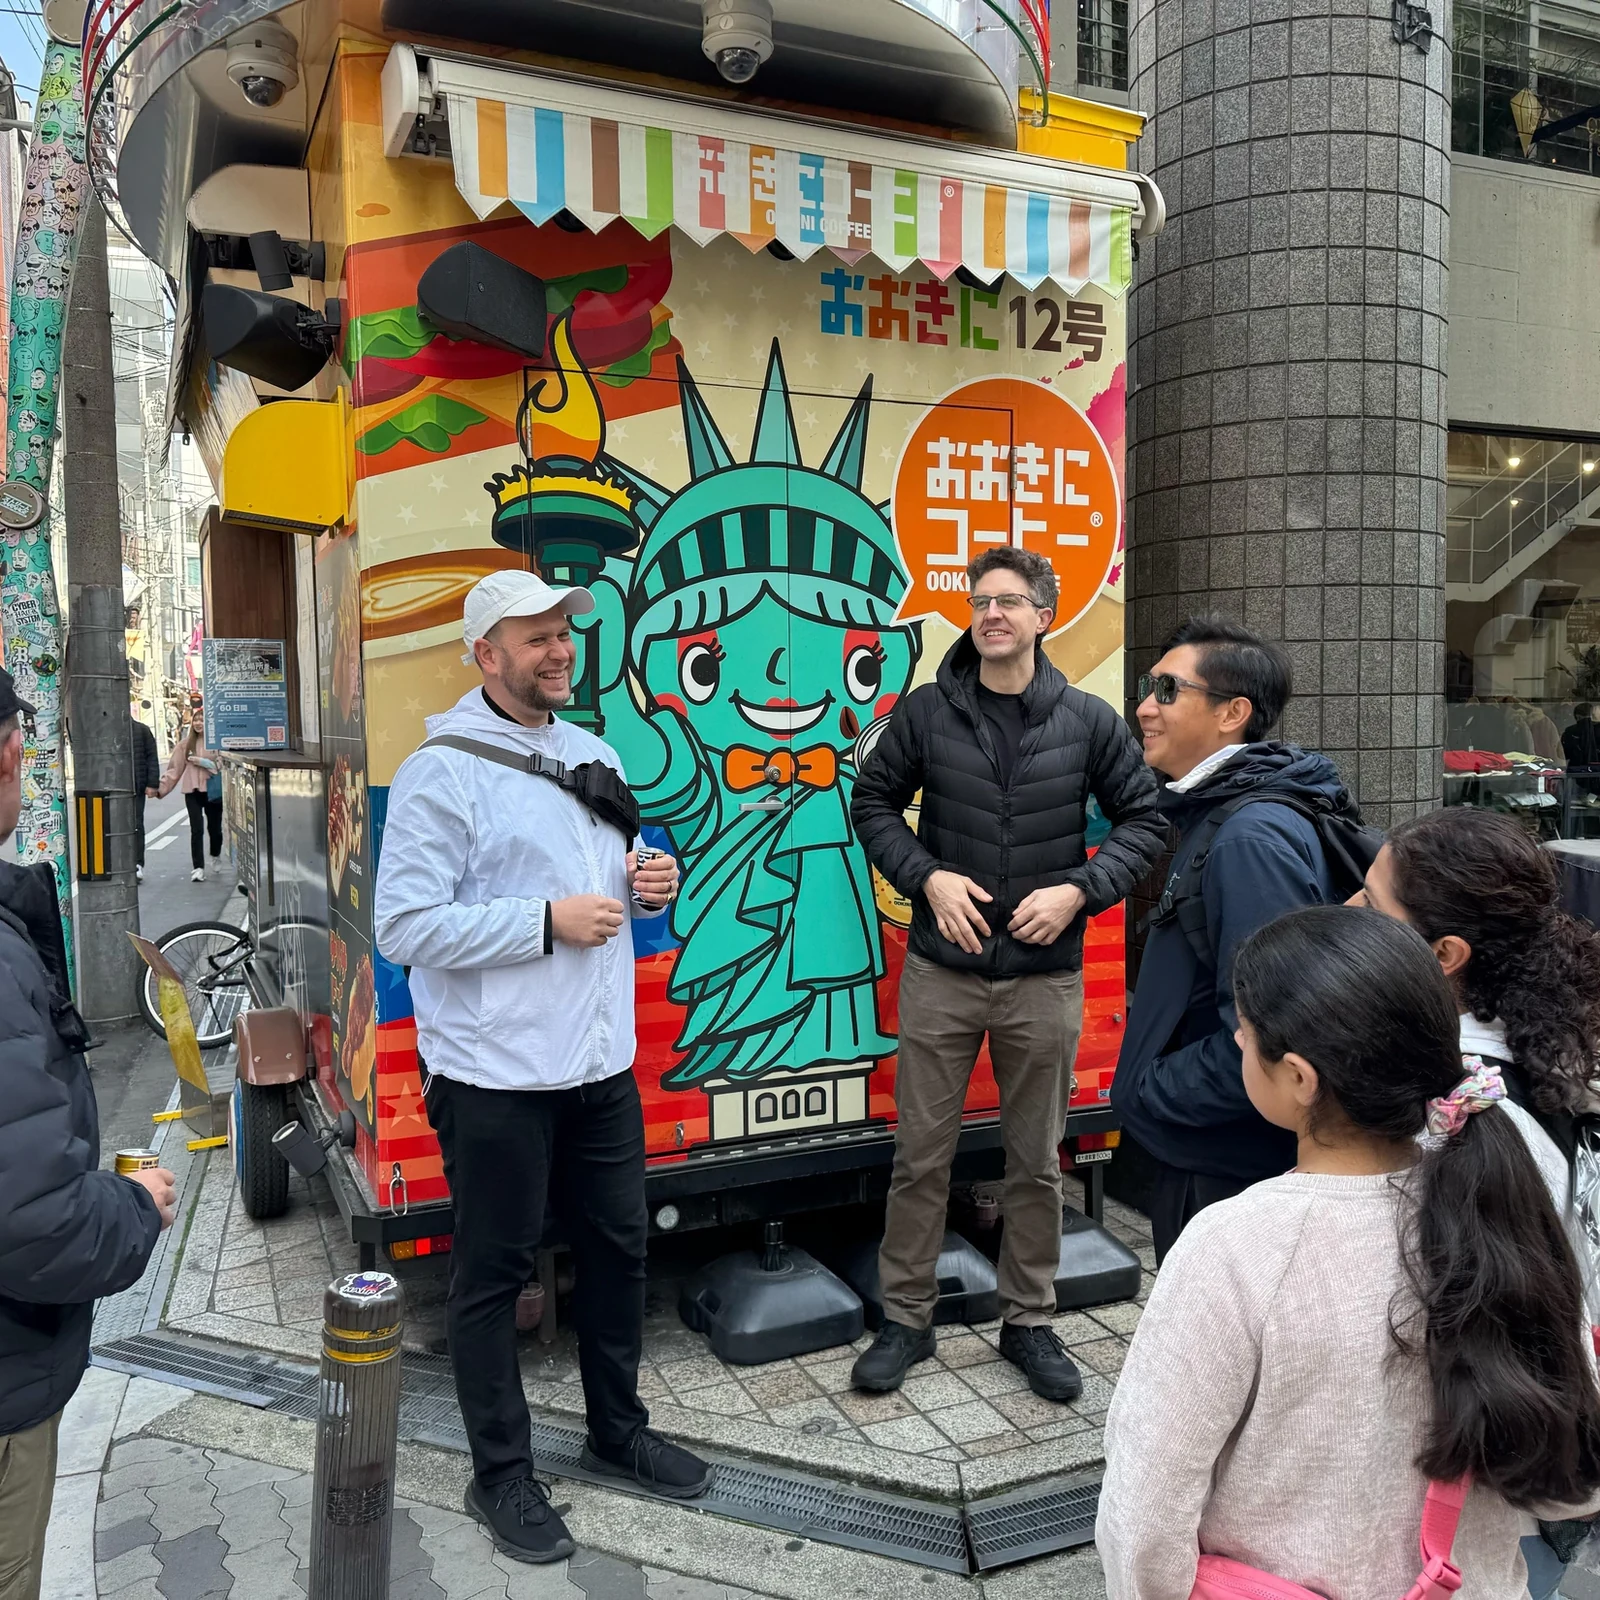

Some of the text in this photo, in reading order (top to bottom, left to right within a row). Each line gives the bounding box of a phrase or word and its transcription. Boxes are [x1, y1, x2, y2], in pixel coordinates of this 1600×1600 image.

[820, 218, 872, 239] COFFEE
[926, 436, 1090, 507] おおきに
[926, 571, 971, 591] OOKI
[11, 599, 37, 612] CYBER
[15, 614, 41, 626] SYSTEM
